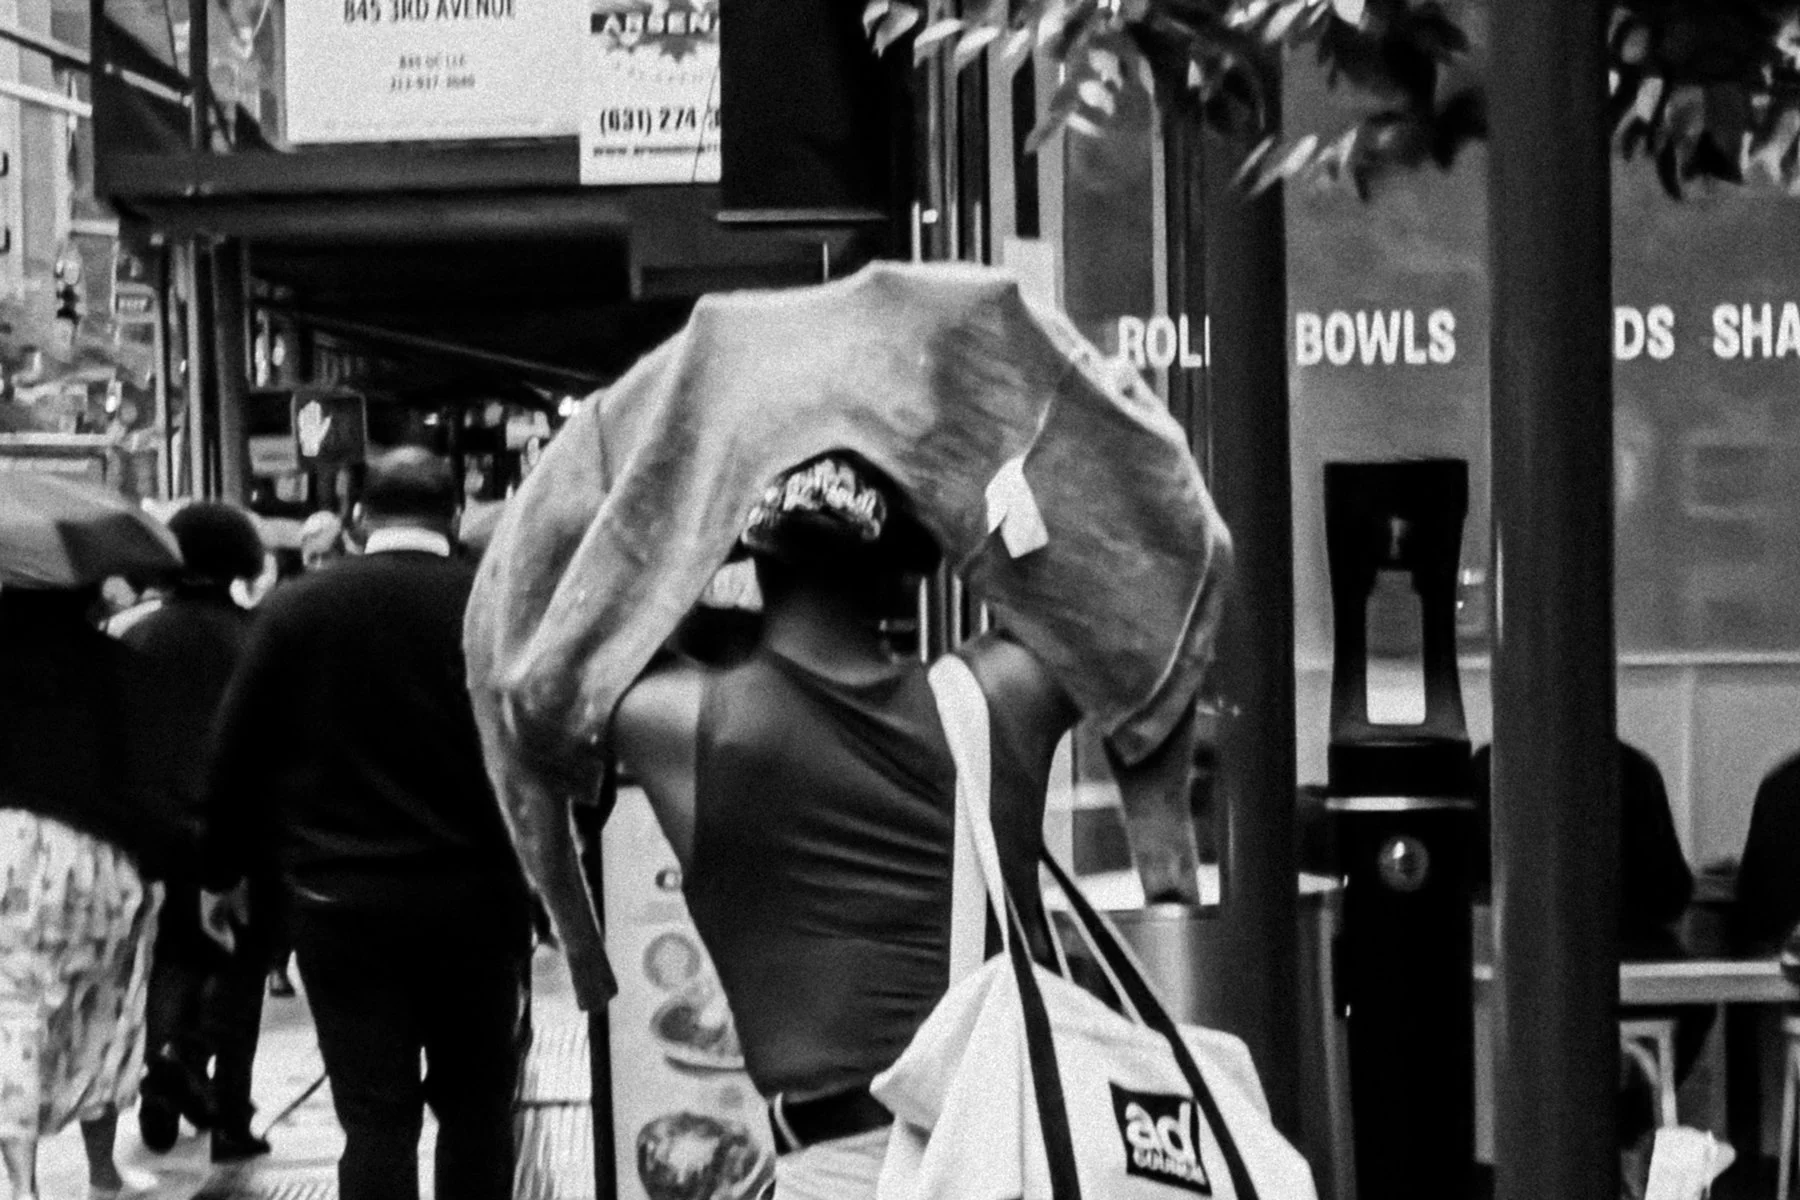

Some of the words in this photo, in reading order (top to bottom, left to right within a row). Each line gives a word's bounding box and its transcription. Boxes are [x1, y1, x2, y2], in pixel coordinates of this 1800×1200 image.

[391, 0, 429, 22] 3RD
[435, 0, 515, 20] AVENUE
[603, 11, 721, 40] ARSEN
[1118, 313, 1211, 369] ROL
[1295, 308, 1457, 367] BOWLS
[1712, 301, 1800, 360] SHA
